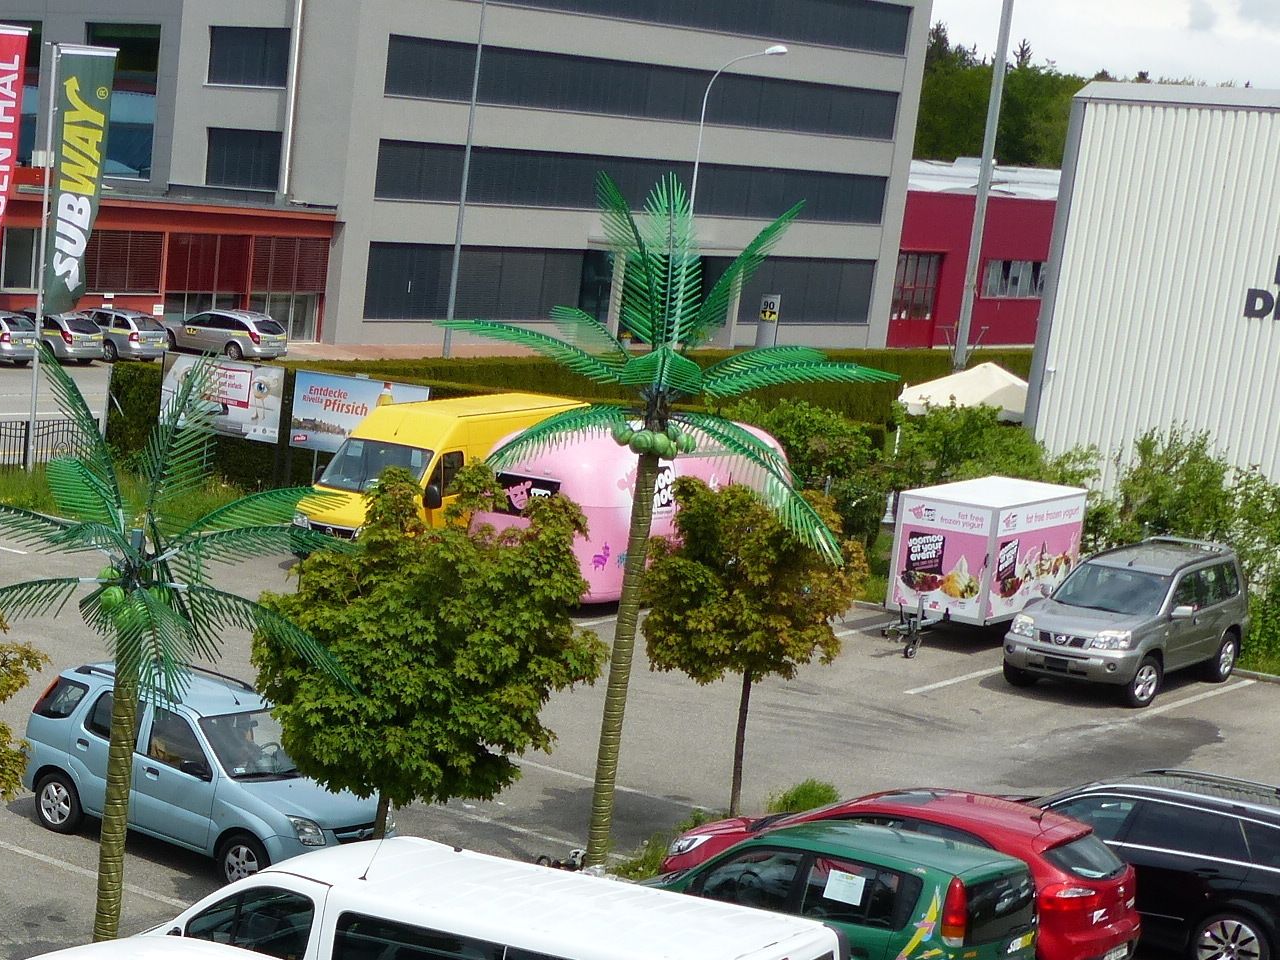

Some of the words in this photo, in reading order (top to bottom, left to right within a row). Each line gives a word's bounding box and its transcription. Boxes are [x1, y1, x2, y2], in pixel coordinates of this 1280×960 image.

[53, 76, 106, 292] SUBWAY
[763, 300, 775, 310] 90
[308, 385, 349, 400] Entdecke
[323, 398, 369, 417] Pfirsich
[940, 515, 962, 526] frozen
[961, 520, 984, 530] yogurt
[958, 511, 969, 521] fat
[969, 513, 984, 523] free
[908, 534, 944, 548] yoomoo
[910, 544, 921, 554] at
[920, 541, 943, 553] your
